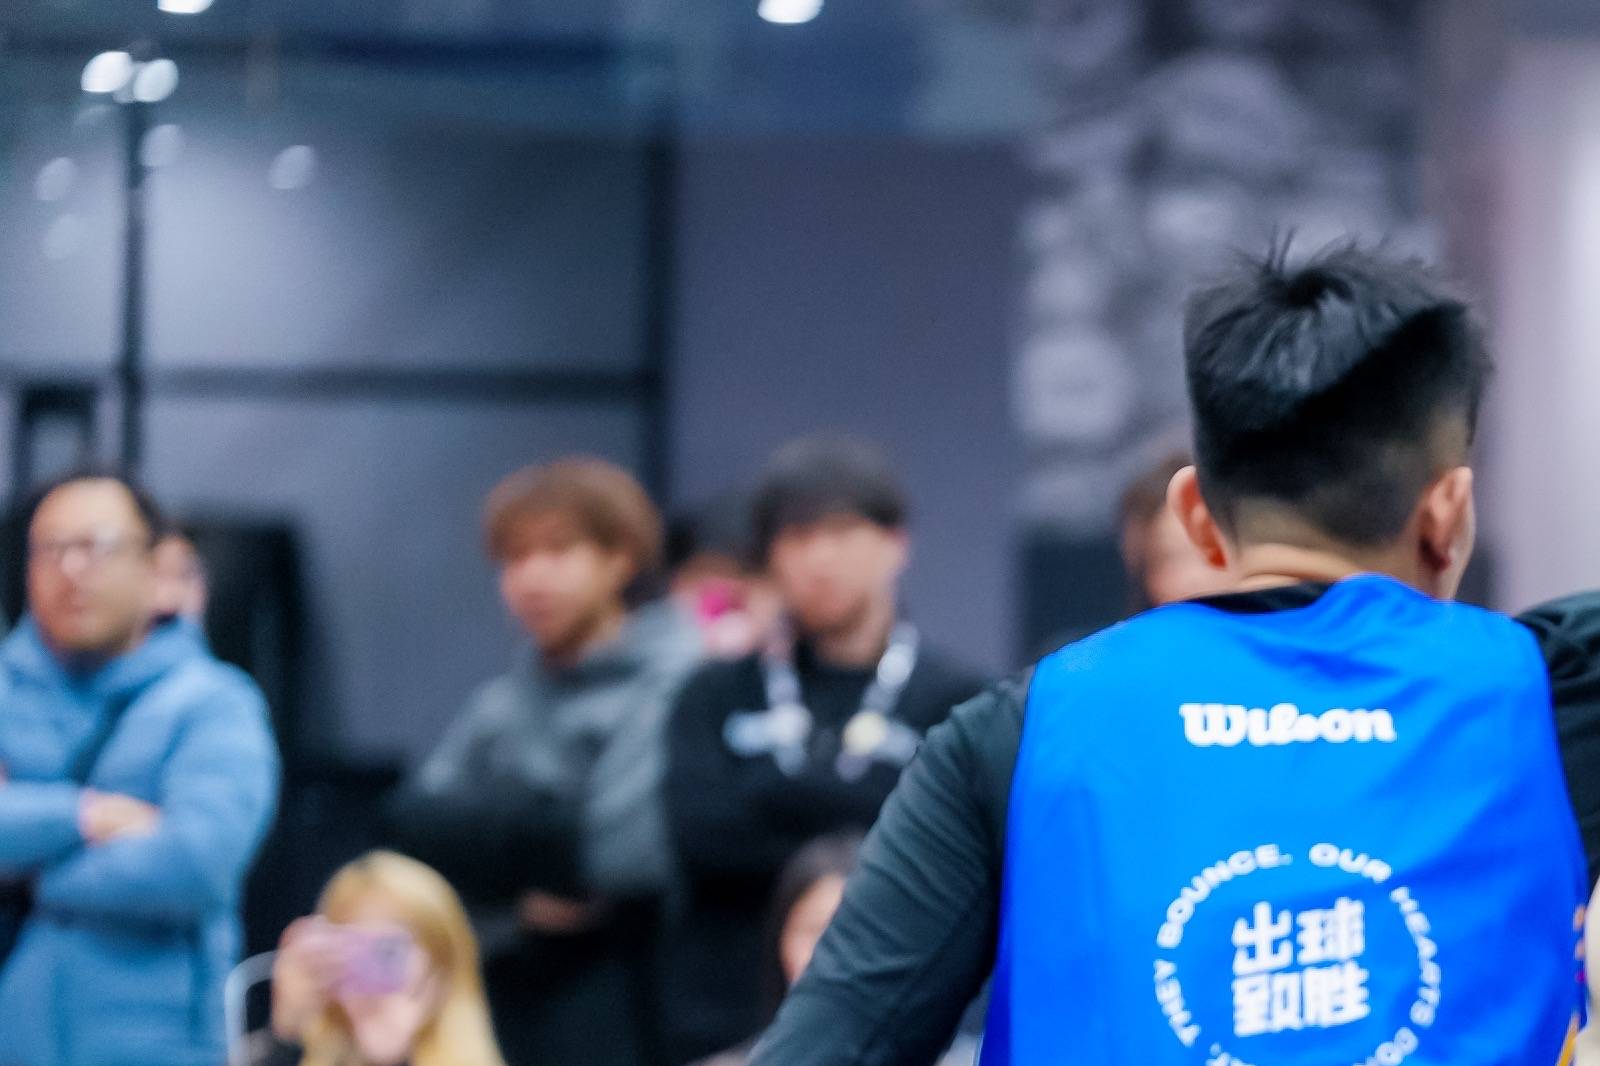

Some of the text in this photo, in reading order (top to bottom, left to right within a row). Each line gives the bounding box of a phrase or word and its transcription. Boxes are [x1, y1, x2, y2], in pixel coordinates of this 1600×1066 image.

[1179, 702, 1396, 746] Wilson
[1309, 843, 1392, 883] OUR
[1390, 886, 1441, 1027] HEARTS
